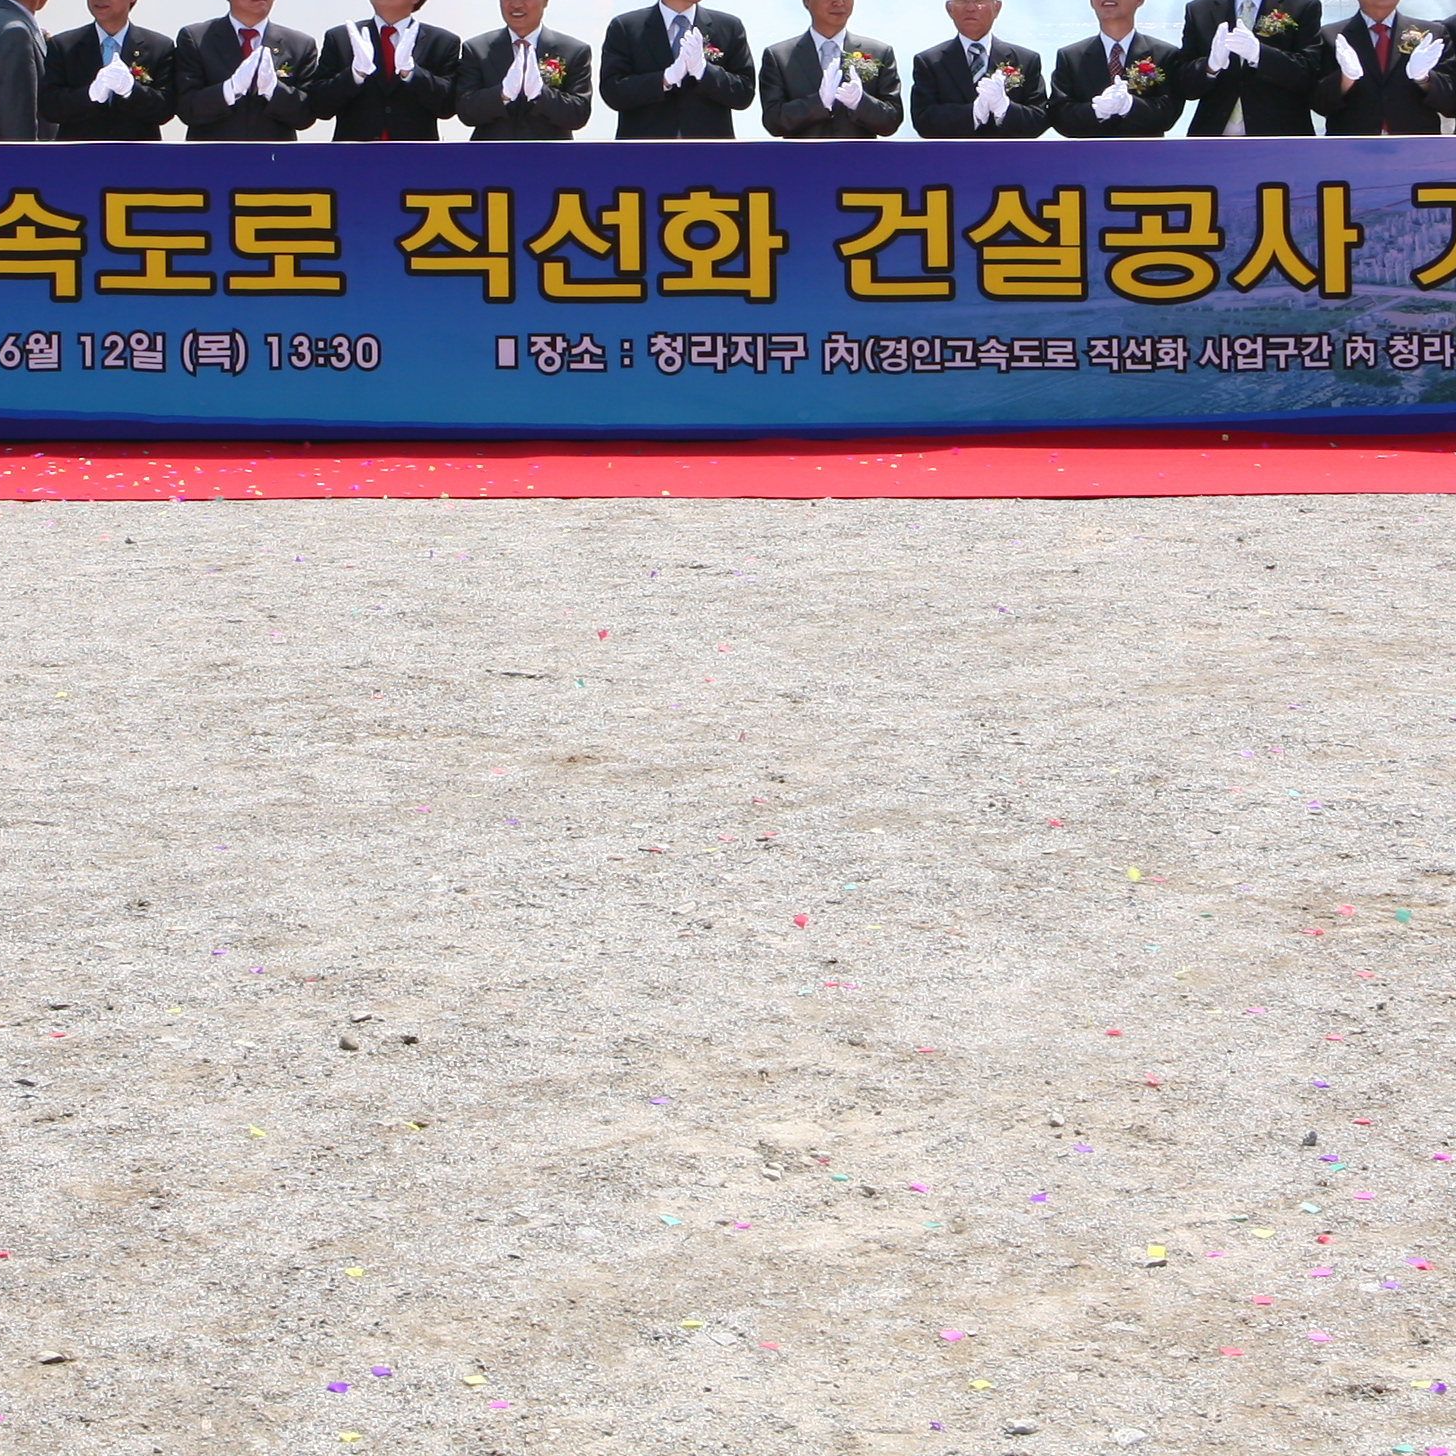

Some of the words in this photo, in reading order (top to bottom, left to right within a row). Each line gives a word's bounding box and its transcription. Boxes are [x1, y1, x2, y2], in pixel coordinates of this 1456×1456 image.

[394, 185, 788, 303] 직선화
[837, 182, 1363, 304] 건설공사
[77, 330, 166, 372] 12일
[181, 329, 248, 375] (목)
[264, 333, 381, 372] 13:30
[528, 333, 607, 375] 장소
[647, 332, 809, 374] 청라지구
[1088, 335, 1190, 373] 직선화
[1194, 333, 1338, 372] 사업구간
[1344, 333, 1376, 369] 內
[1388, 332, 1454, 369] 청라
